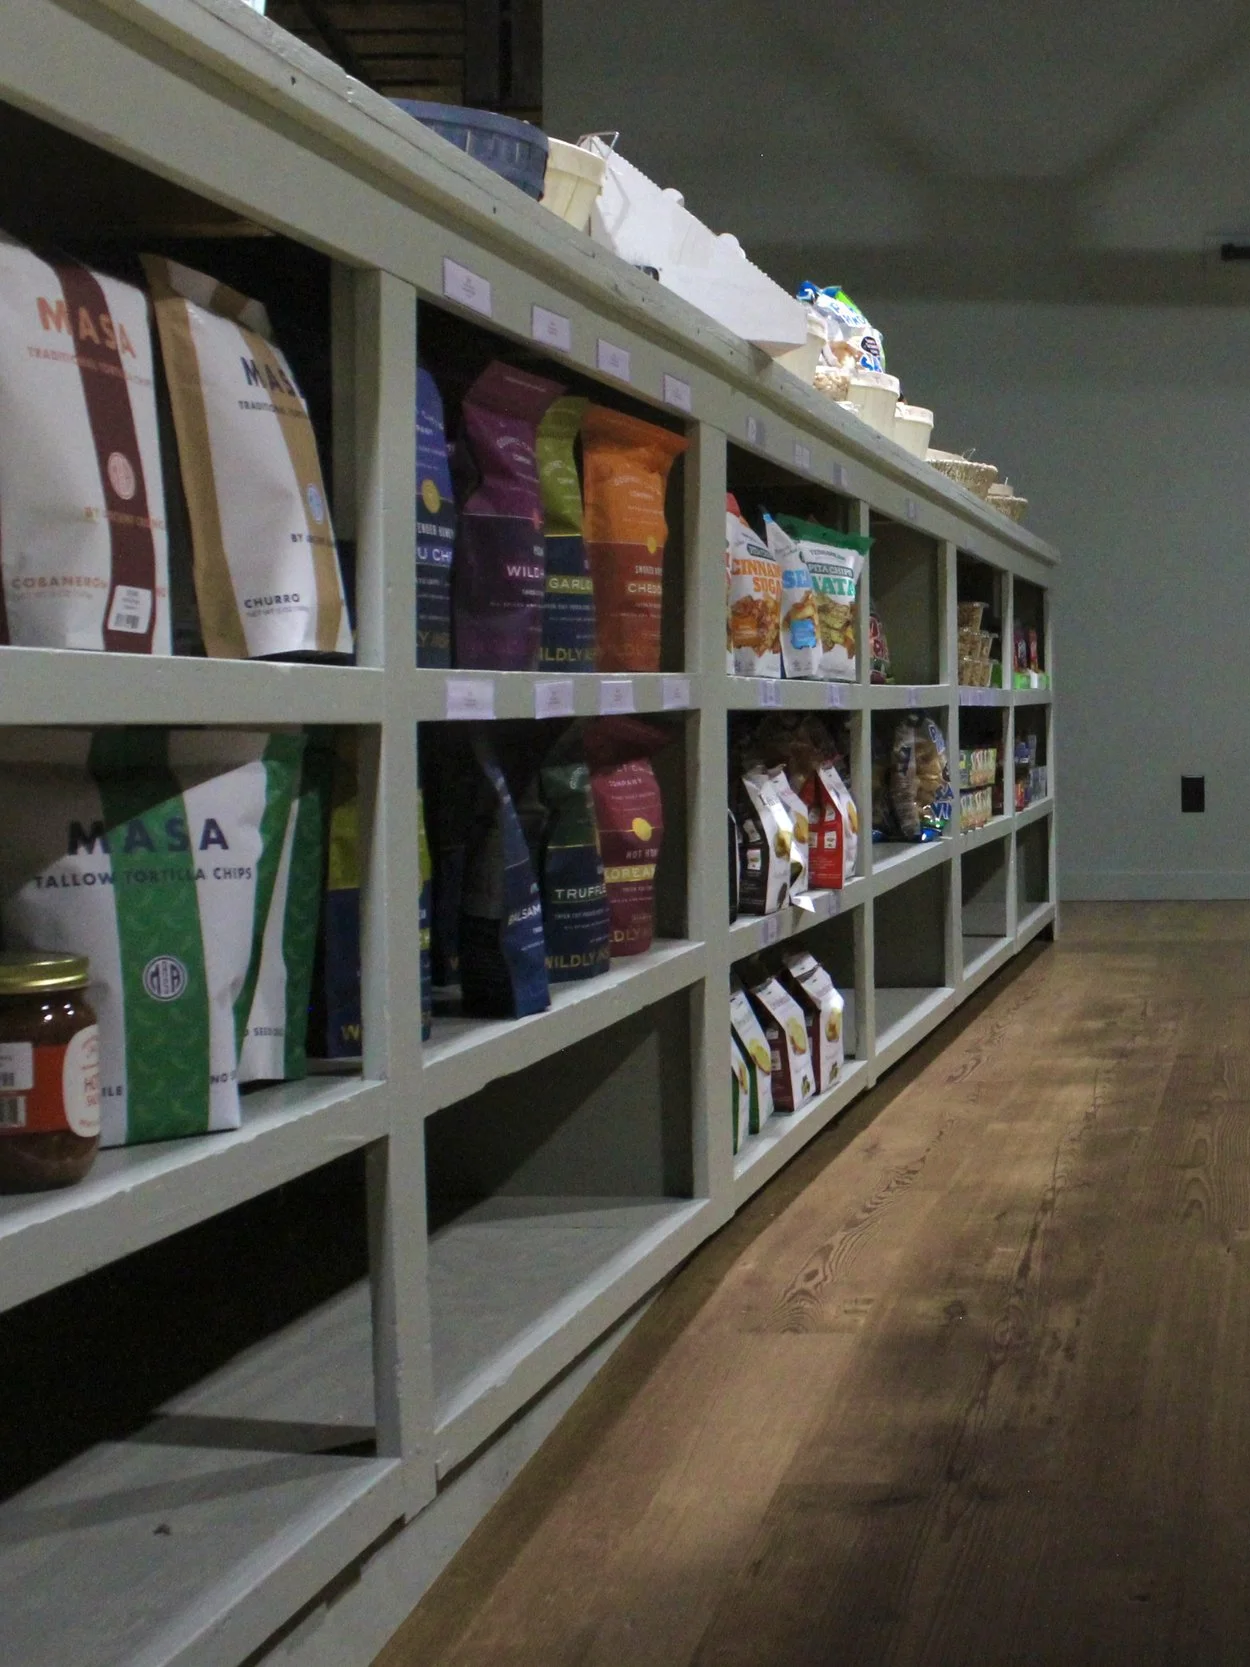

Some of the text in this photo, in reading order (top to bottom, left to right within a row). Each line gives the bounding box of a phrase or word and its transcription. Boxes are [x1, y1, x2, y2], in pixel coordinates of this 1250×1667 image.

[36, 297, 136, 359] MASA
[244, 594, 301, 609] CHURRO
[67, 818, 229, 855] MASA
[36, 866, 252, 889] TALLOW TORTILLA CHIPS
[211, 1073, 228, 1084] NO
